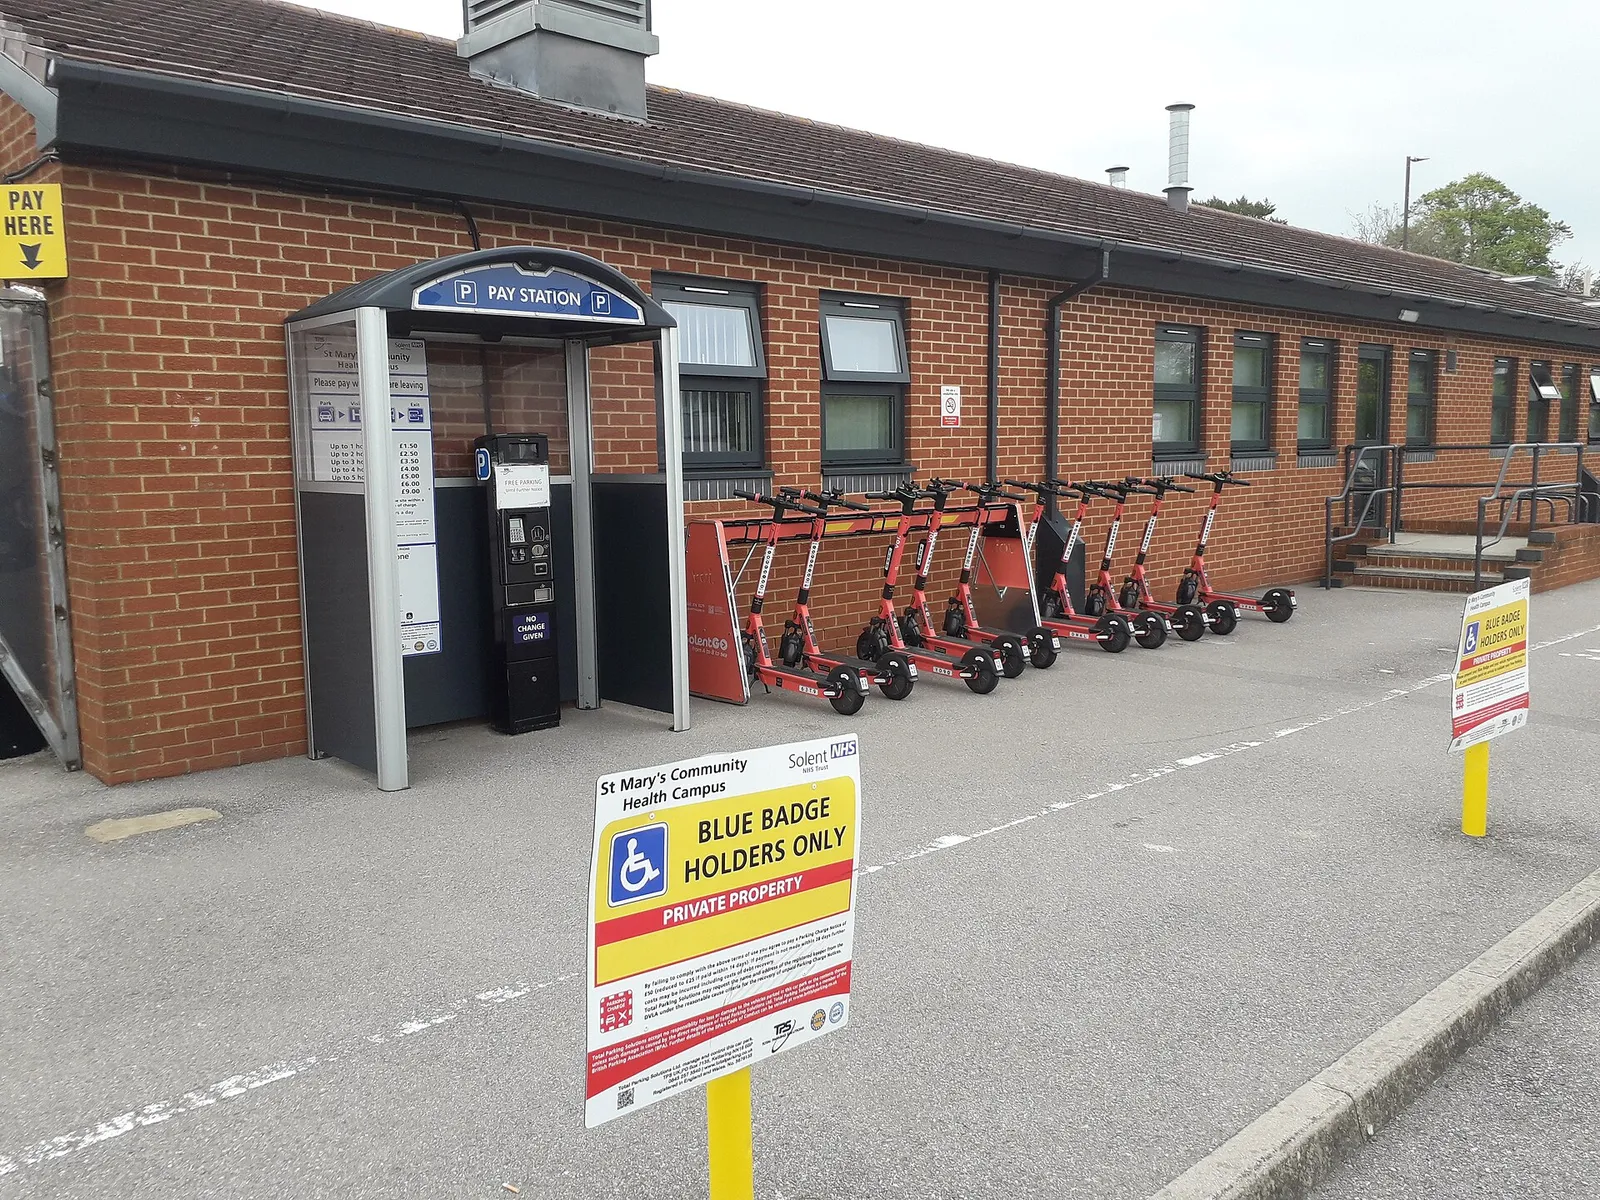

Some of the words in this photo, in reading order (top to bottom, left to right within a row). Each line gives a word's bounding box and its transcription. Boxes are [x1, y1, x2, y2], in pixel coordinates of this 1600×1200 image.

[9, 191, 44, 210] PAY
[4, 216, 54, 235] HERE
[461, 284, 472, 300] P
[488, 286, 516, 301] PAY
[520, 288, 580, 306] STATION
[596, 296, 606, 310] P
[335, 351, 358, 360] Mary'
[314, 378, 335, 387] Please
[338, 380, 350, 389] pay
[400, 382, 423, 391] leaving
[478, 454, 485, 475] P
[518, 623, 545, 632] CHANGE
[1486, 617, 1500, 630] BLUE
[1502, 610, 1520, 625] BADGE
[523, 632, 543, 640] GIVEN
[688, 634, 728, 650] olentGO
[1480, 630, 1507, 648] HOLDERS
[1509, 624, 1524, 639] ONLY
[1473, 653, 1491, 665] PRIVATE
[1491, 647, 1512, 659] PROPERTY
[789, 750, 828, 769] Solent
[832, 741, 856, 758] NHS
[600, 782, 615, 795] St
[621, 772, 666, 792] Mary's
[671, 758, 748, 782] Community
[623, 791, 667, 811] Health
[672, 782, 726, 801] Campus
[699, 812, 753, 844] BLUE
[762, 797, 830, 830] BADGE
[685, 840, 785, 883] HOLDERS
[793, 826, 846, 856] ONLY
[663, 892, 725, 924] PRIVATE
[729, 875, 803, 908] PROPERTY
[652, 976, 668, 987] failing
[676, 968, 693, 979] comply
[716, 957, 730, 966] above
[731, 953, 743, 961] terms
[798, 931, 813, 940] Parking
[814, 926, 828, 935] Charge
[654, 982, 677, 994] (reduced
[701, 971, 711, 979] paid
[756, 950, 774, 961] payment
[644, 996, 657, 1005] costs
[659, 993, 669, 1001] may
[679, 982, 699, 993] incurred
[701, 974, 722, 987] including
[606, 996, 626, 1006] PARKING
[644, 1004, 657, 1013] Total
[658, 997, 677, 1009] Parking
[678, 989, 700, 1001] Solutions
[644, 1010, 658, 1020] DVLA
[773, 1019, 791, 1036] TPS
